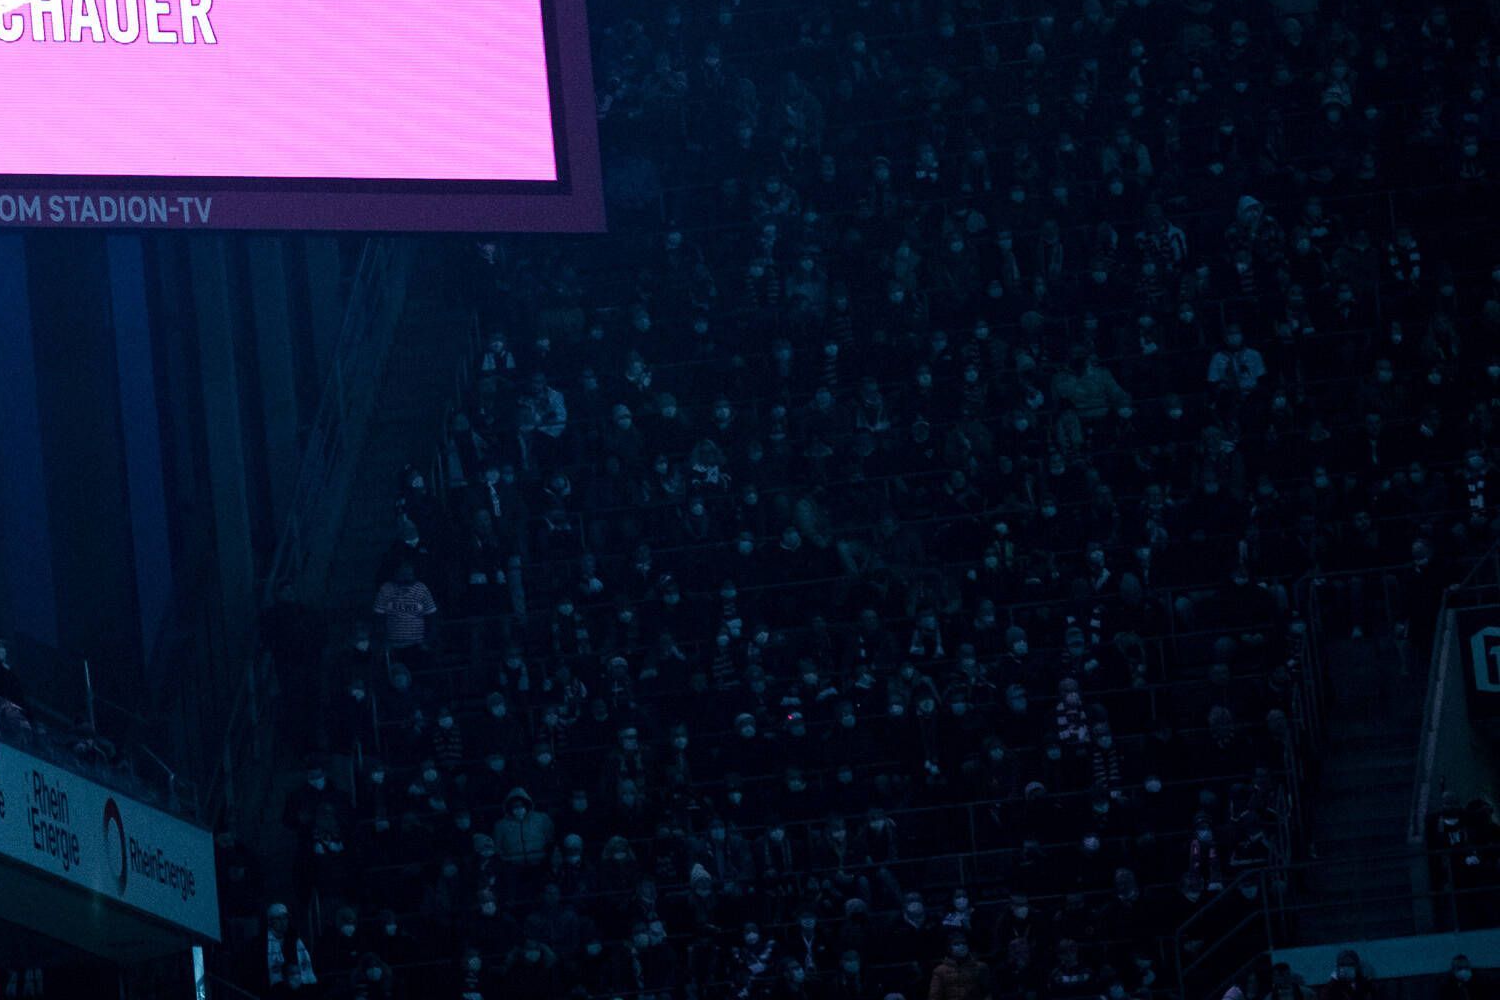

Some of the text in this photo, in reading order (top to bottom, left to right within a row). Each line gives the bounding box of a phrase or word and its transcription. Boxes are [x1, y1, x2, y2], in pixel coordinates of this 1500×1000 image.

[49, 195, 212, 224] STADION-TV
[31, 770, 70, 828] Rhein
[29, 806, 80, 872] Energie
[129, 835, 196, 902] RheinEnergie
